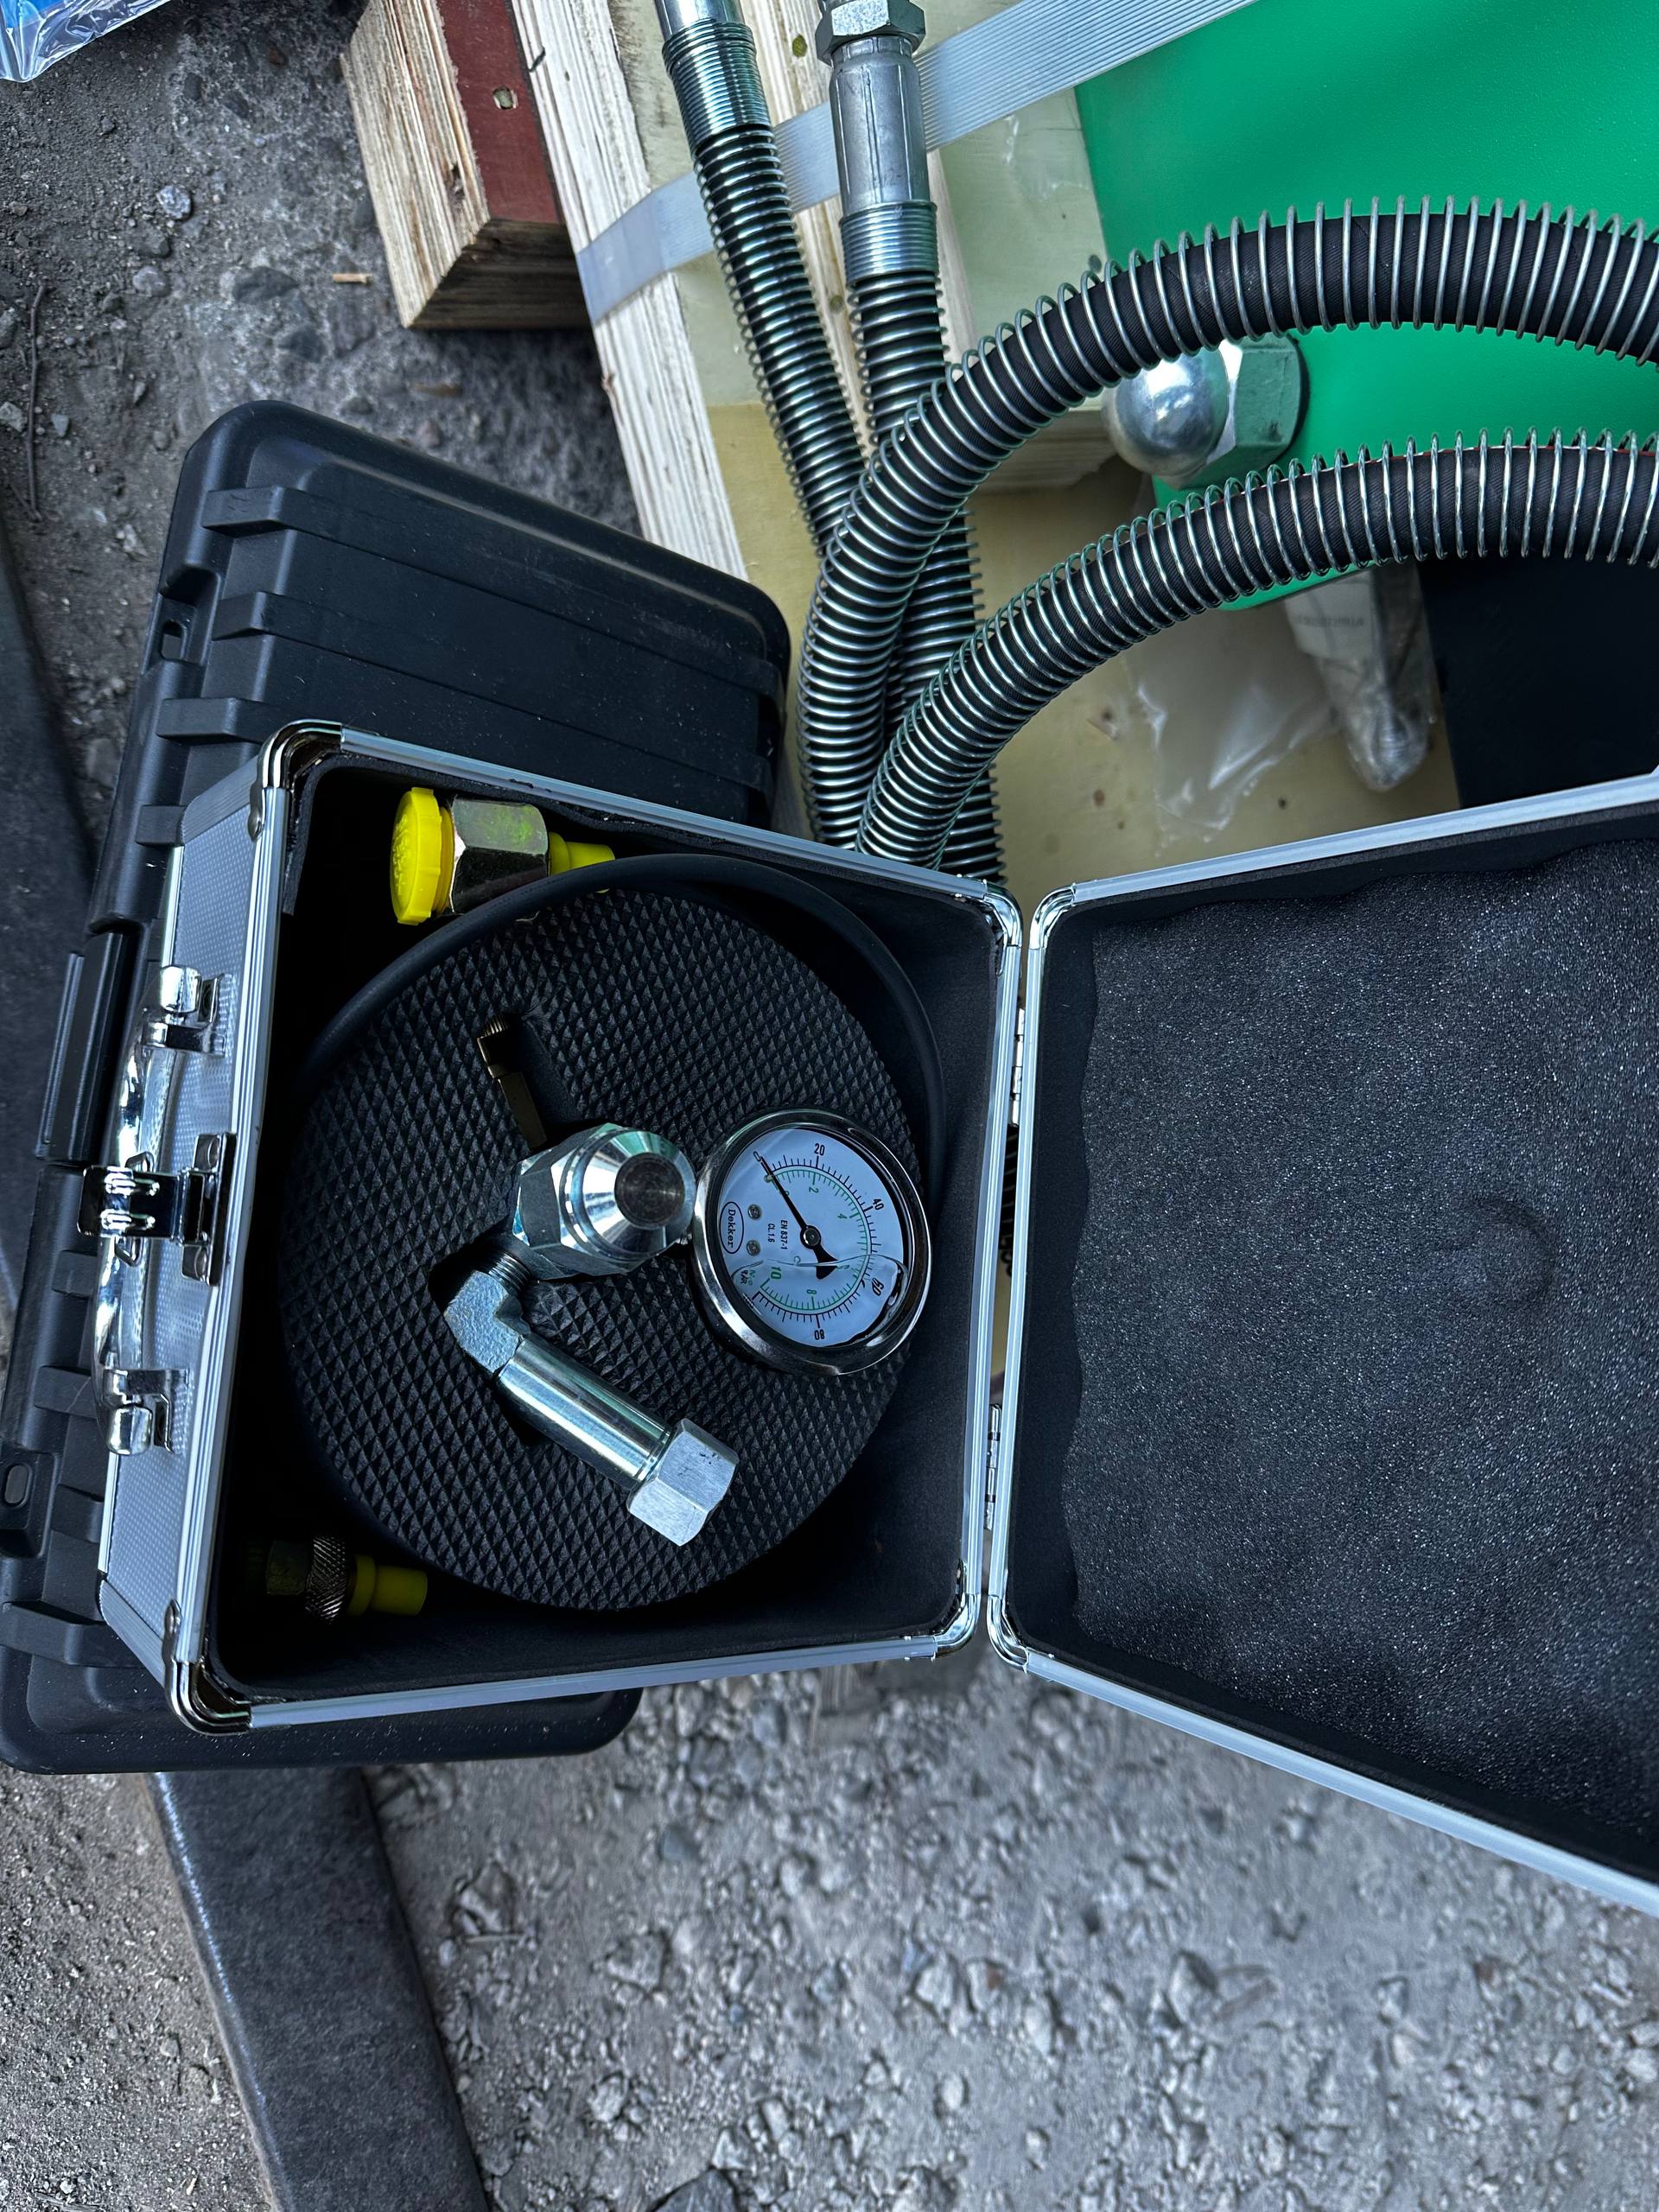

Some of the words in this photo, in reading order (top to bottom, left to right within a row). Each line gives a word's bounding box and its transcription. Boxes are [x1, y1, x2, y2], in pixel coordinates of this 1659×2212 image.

[814, 1143, 825, 1156] 20
[873, 1198, 885, 1211] 40
[728, 1209, 736, 1249] Dekker
[780, 1219, 788, 1230] EN
[770, 1266, 782, 1280] 10
[814, 1329, 825, 1340] 80
